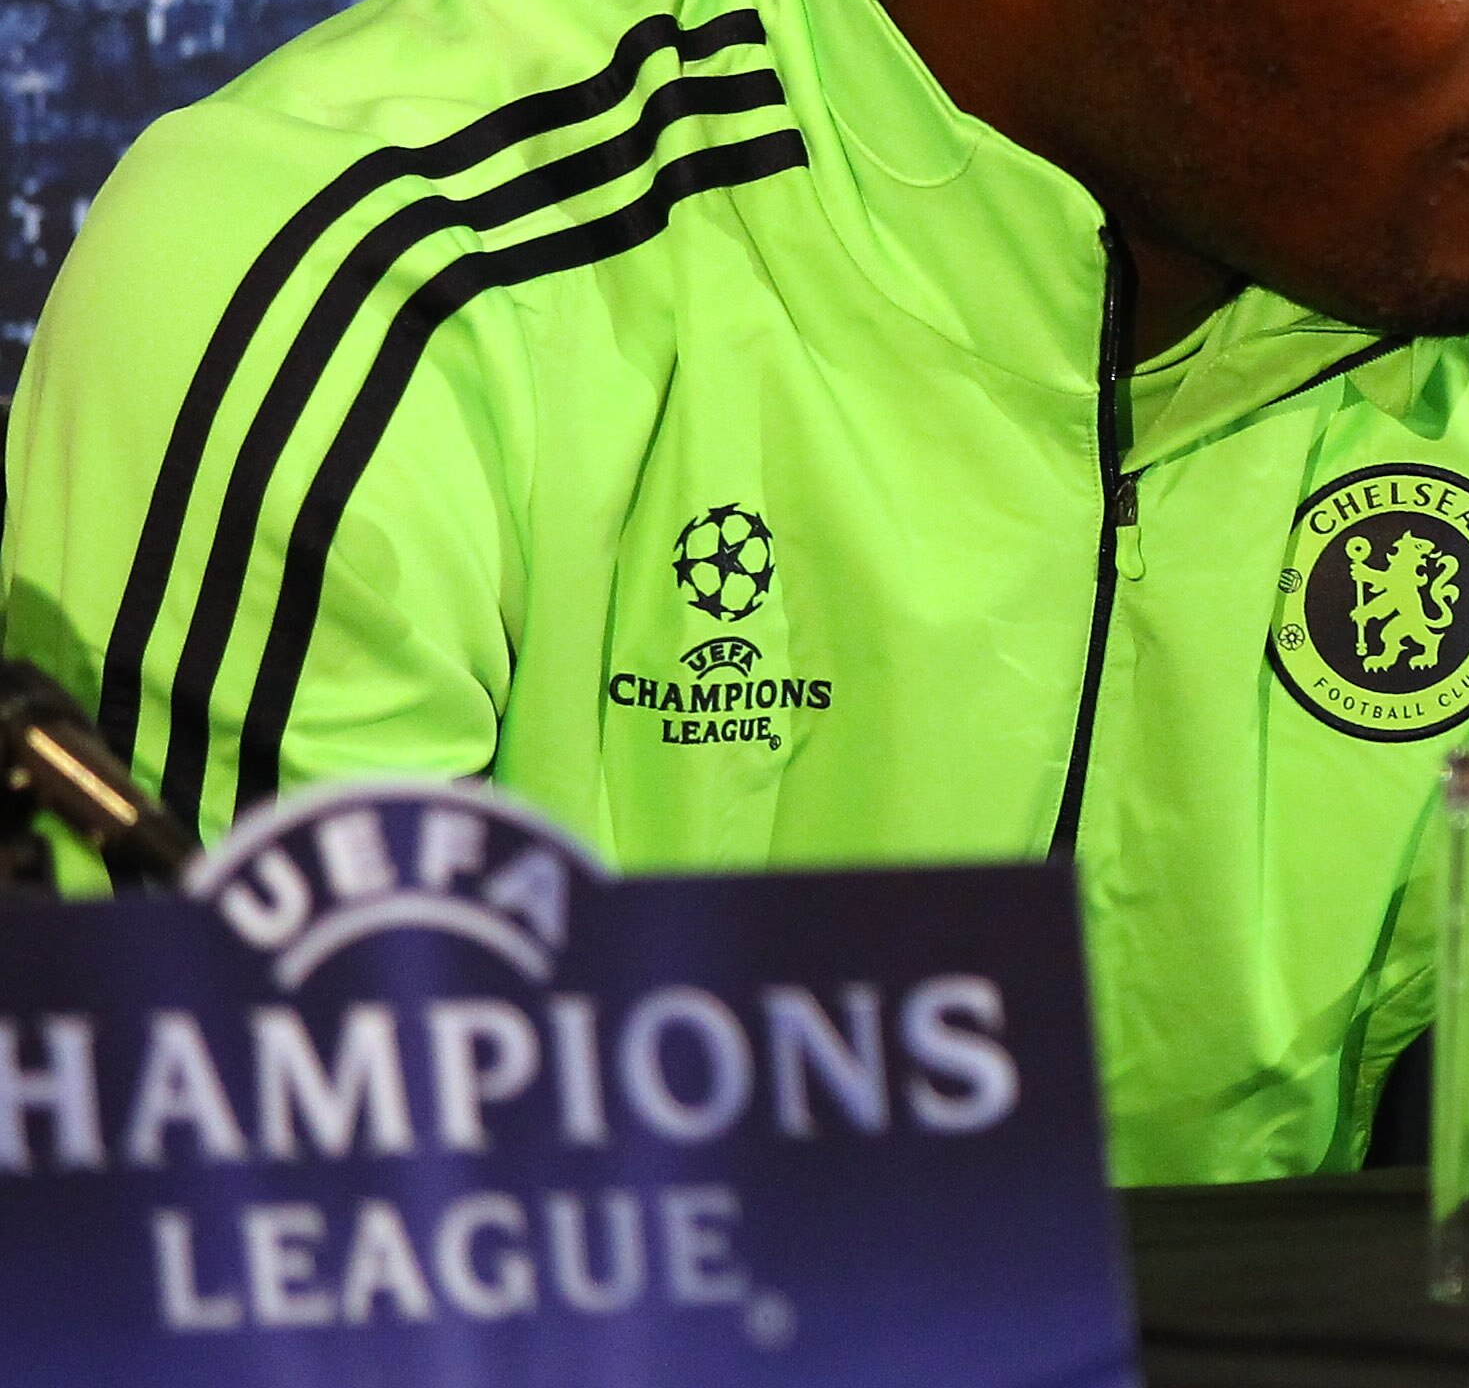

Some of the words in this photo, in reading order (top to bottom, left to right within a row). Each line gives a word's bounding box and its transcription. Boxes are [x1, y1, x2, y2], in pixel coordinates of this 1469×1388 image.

[688, 644, 752, 672] UEFA
[609, 673, 832, 713] CHAMPIONS
[1314, 677, 1424, 719] FOOTBALL
[662, 717, 773, 744] LEAGUE
[217, 807, 571, 950] UEFA
[148, 1186, 752, 1334] LEAGUE
